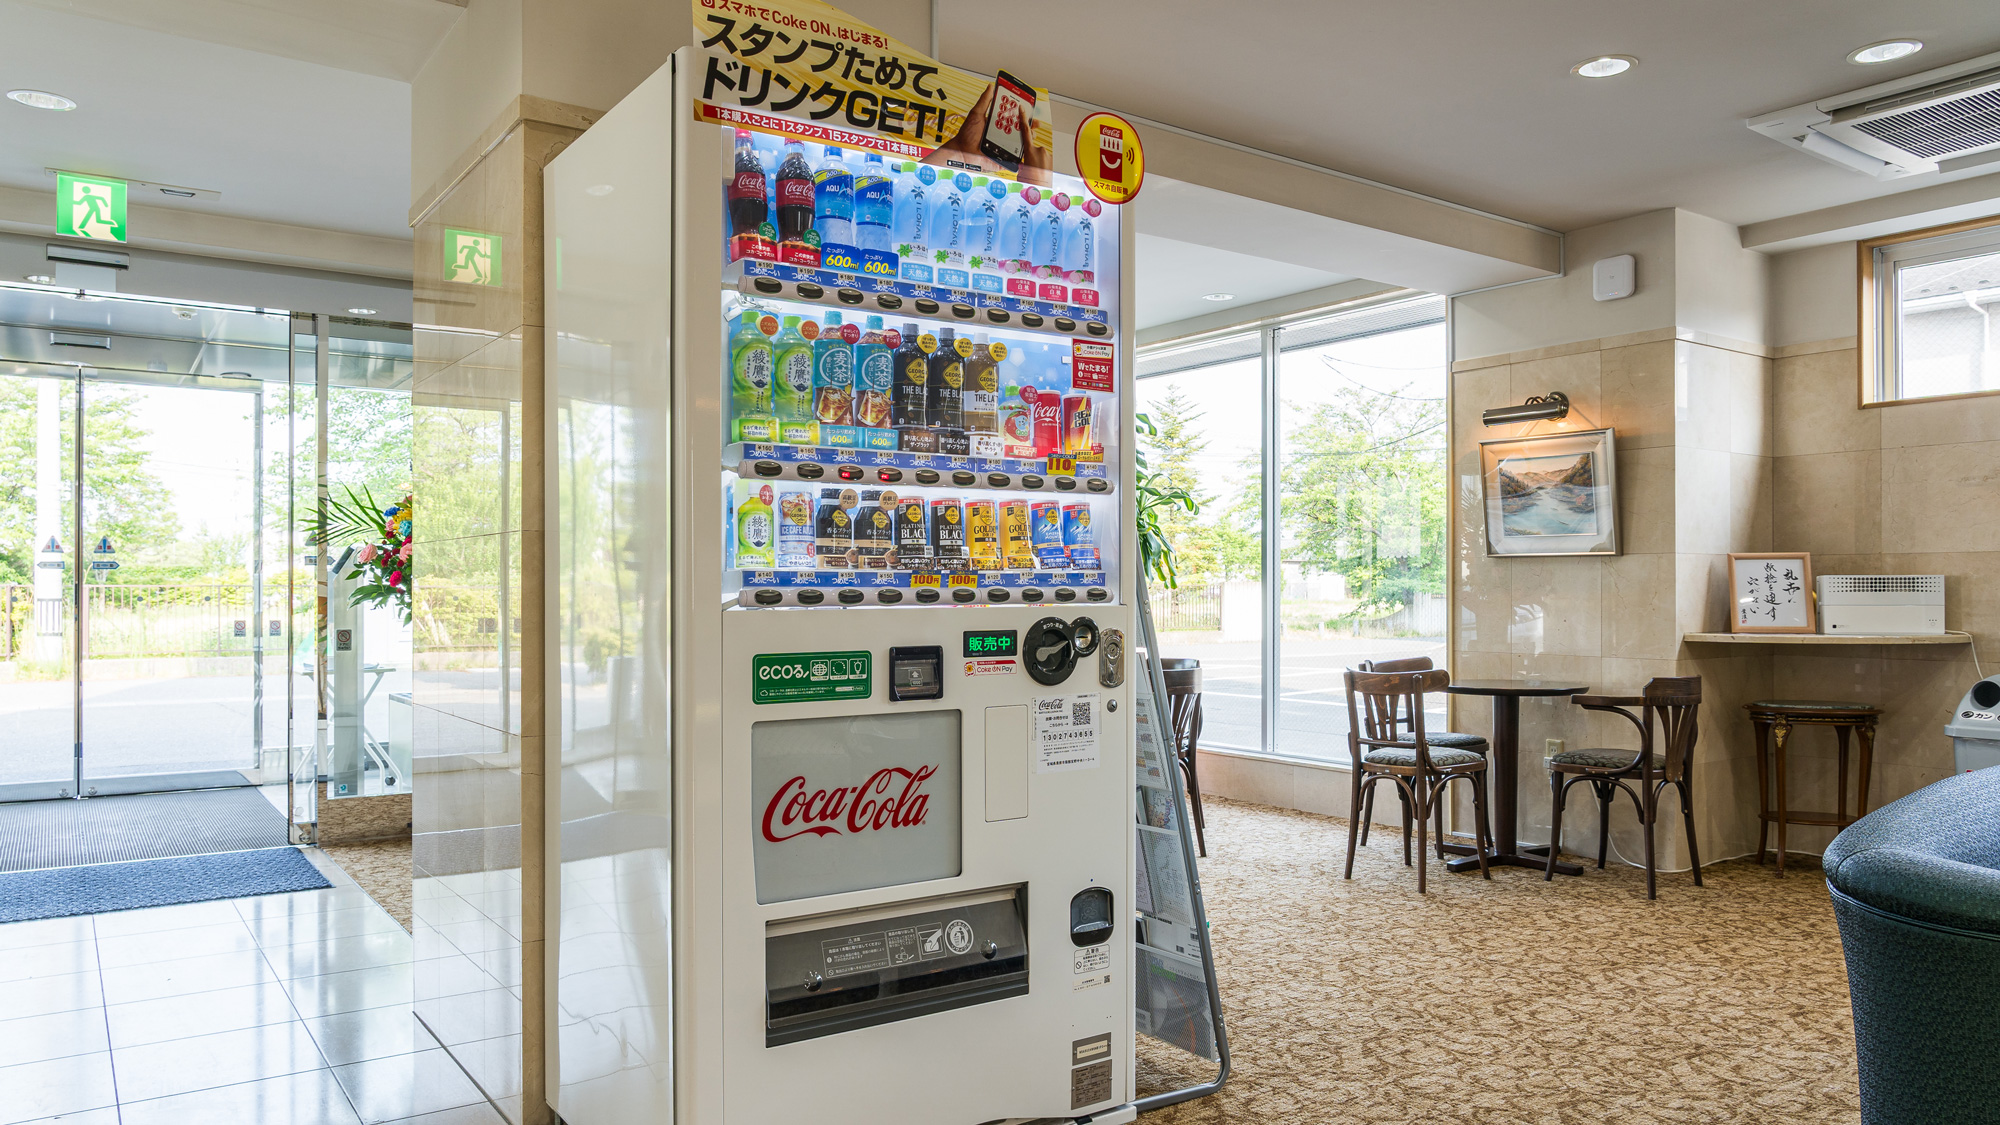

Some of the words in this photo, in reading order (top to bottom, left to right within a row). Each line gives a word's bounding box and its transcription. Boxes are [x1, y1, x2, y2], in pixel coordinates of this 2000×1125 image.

[701, 14, 948, 101] スタンプためて、
[702, 56, 947, 143] ドリンクGET!
[1093, 180, 1129, 196] スマホ自販機
[825, 247, 845, 255] たっぷり
[864, 253, 883, 261] たっぷり
[825, 254, 860, 270] 600ml
[864, 260, 897, 276] 600ml
[907, 268, 930, 279] 天然水
[943, 274, 966, 284] 天然水
[978, 279, 1000, 289] 天然水
[751, 349, 766, 379] 綾鷹
[793, 353, 807, 384] 綾鷹
[833, 351, 848, 382] 麦茶
[874, 356, 889, 386] 麦茶
[902, 386, 915, 394] THE
[939, 389, 952, 397] THE
[974, 393, 987, 402] THE
[1048, 457, 1076, 472] 110円
[751, 515, 764, 540] 綾鷹
[912, 575, 940, 584] 100円
[950, 575, 976, 584] 100円
[968, 635, 1011, 652] 販売中
[991, 665, 1001, 673] ON
[1001, 666, 1013, 674] Pay
[1038, 698, 1065, 711] Coca-Cola
[761, 763, 940, 843] Coca-Cola
